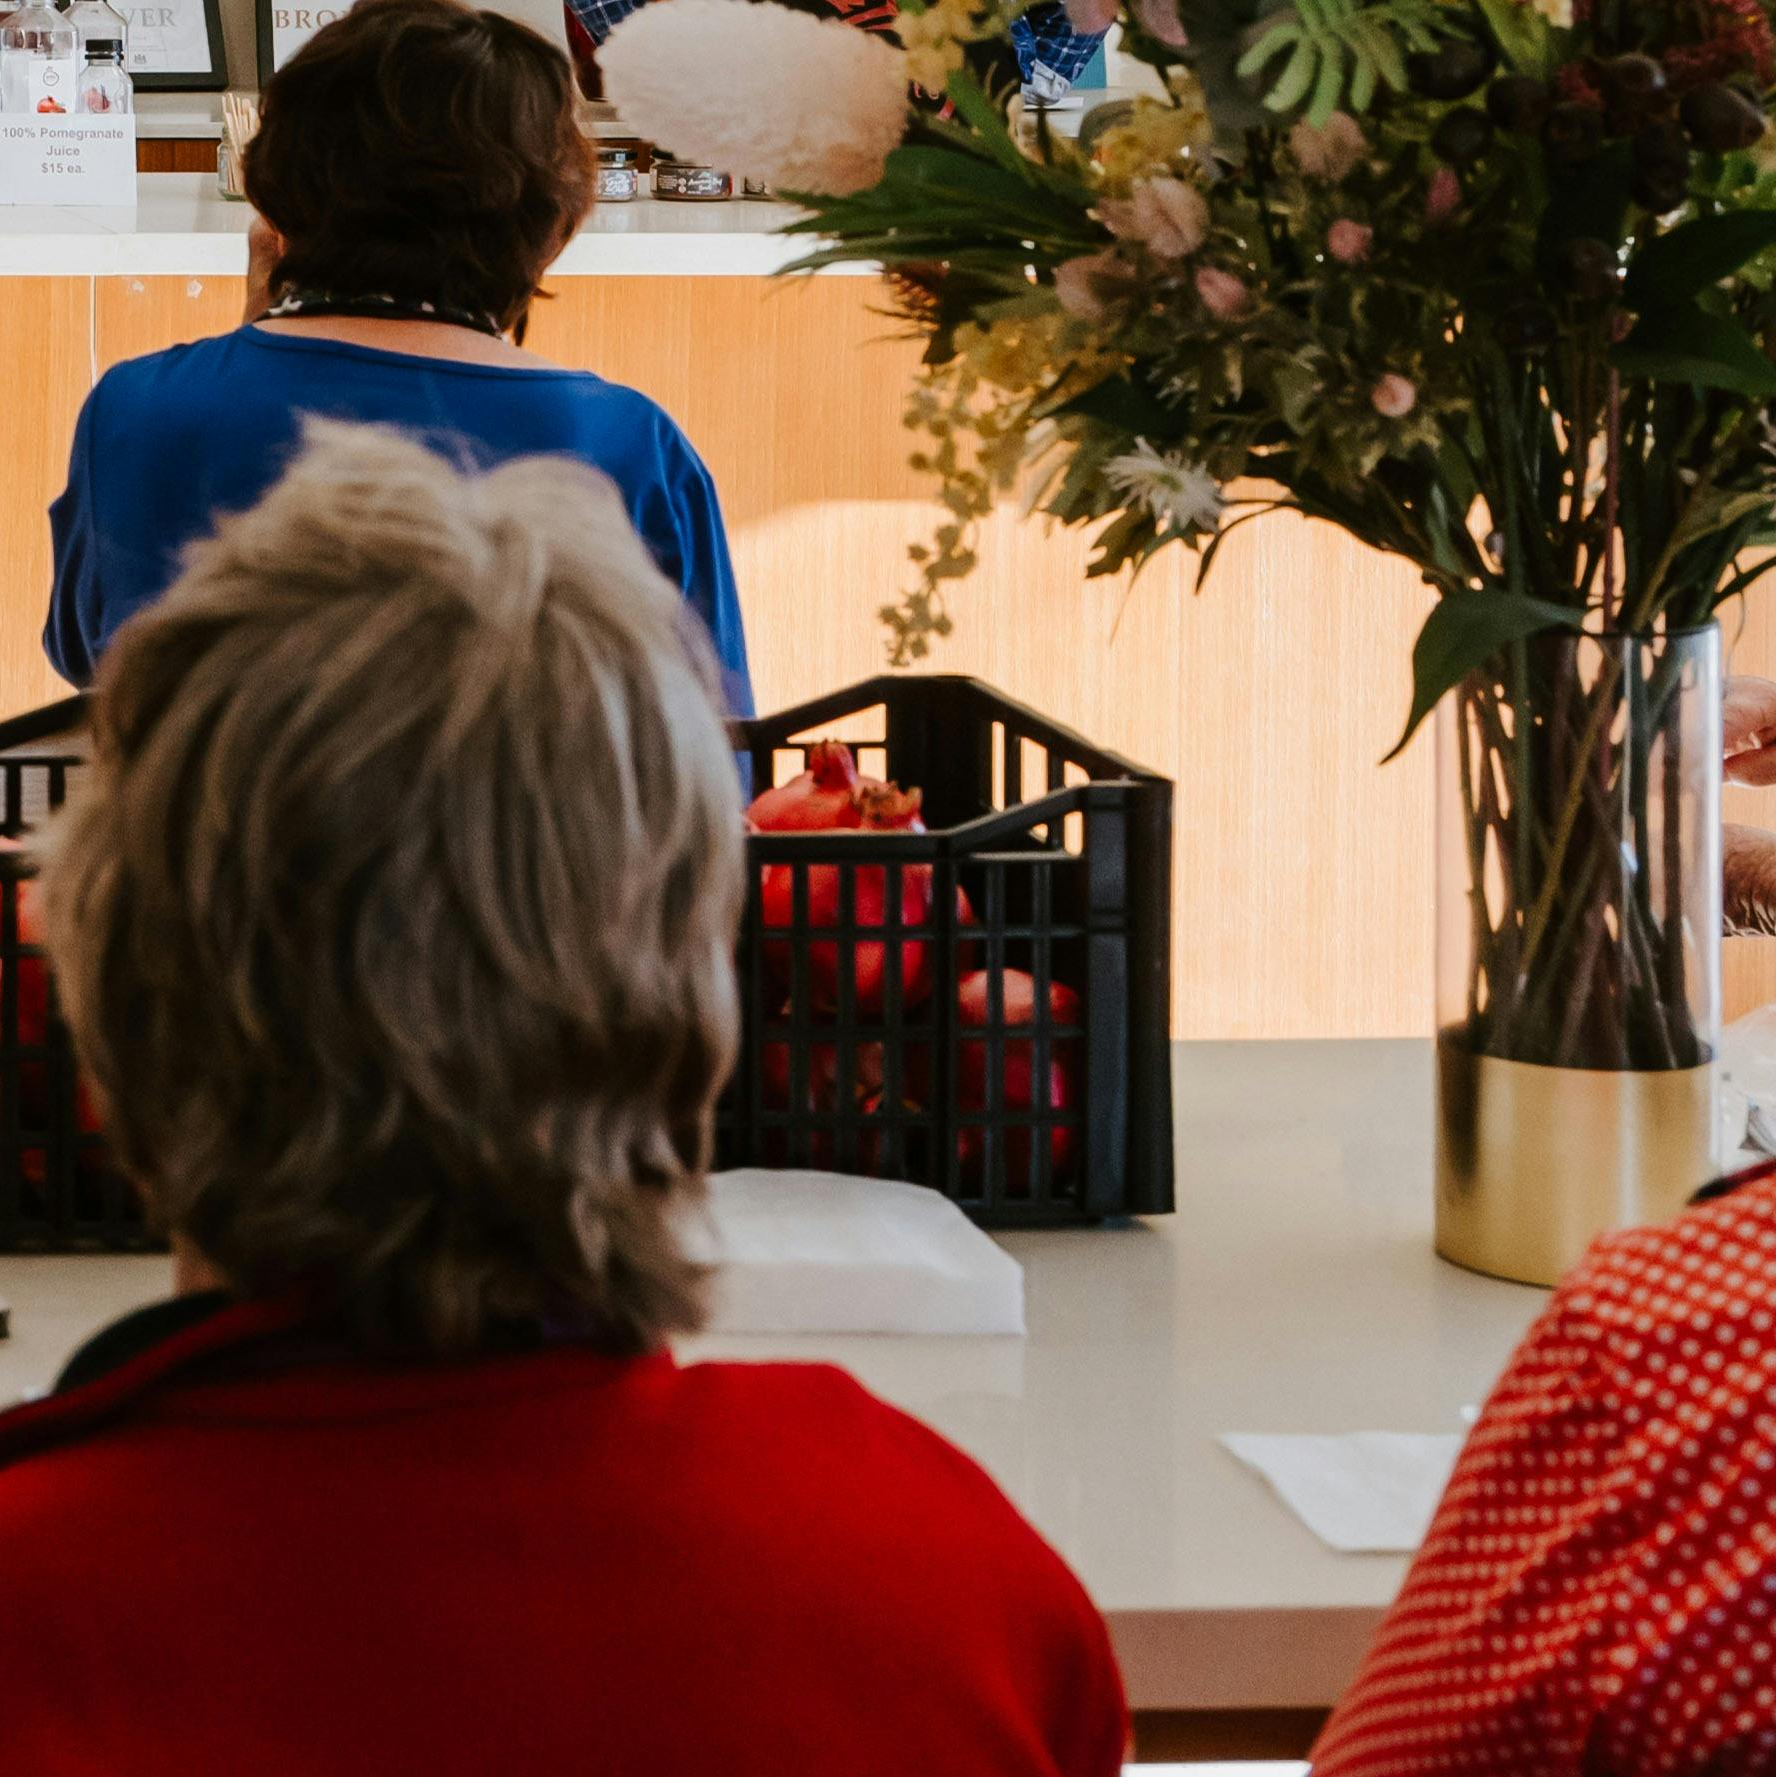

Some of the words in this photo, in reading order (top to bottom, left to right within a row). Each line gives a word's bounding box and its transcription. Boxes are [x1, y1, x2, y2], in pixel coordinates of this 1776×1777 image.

[3, 127, 36, 138] 100%
[40, 127, 124, 140] Pomegranate
[46, 145, 81, 156] Juice
[41, 162, 64, 174] $15
[67, 164, 86, 174] ea.
